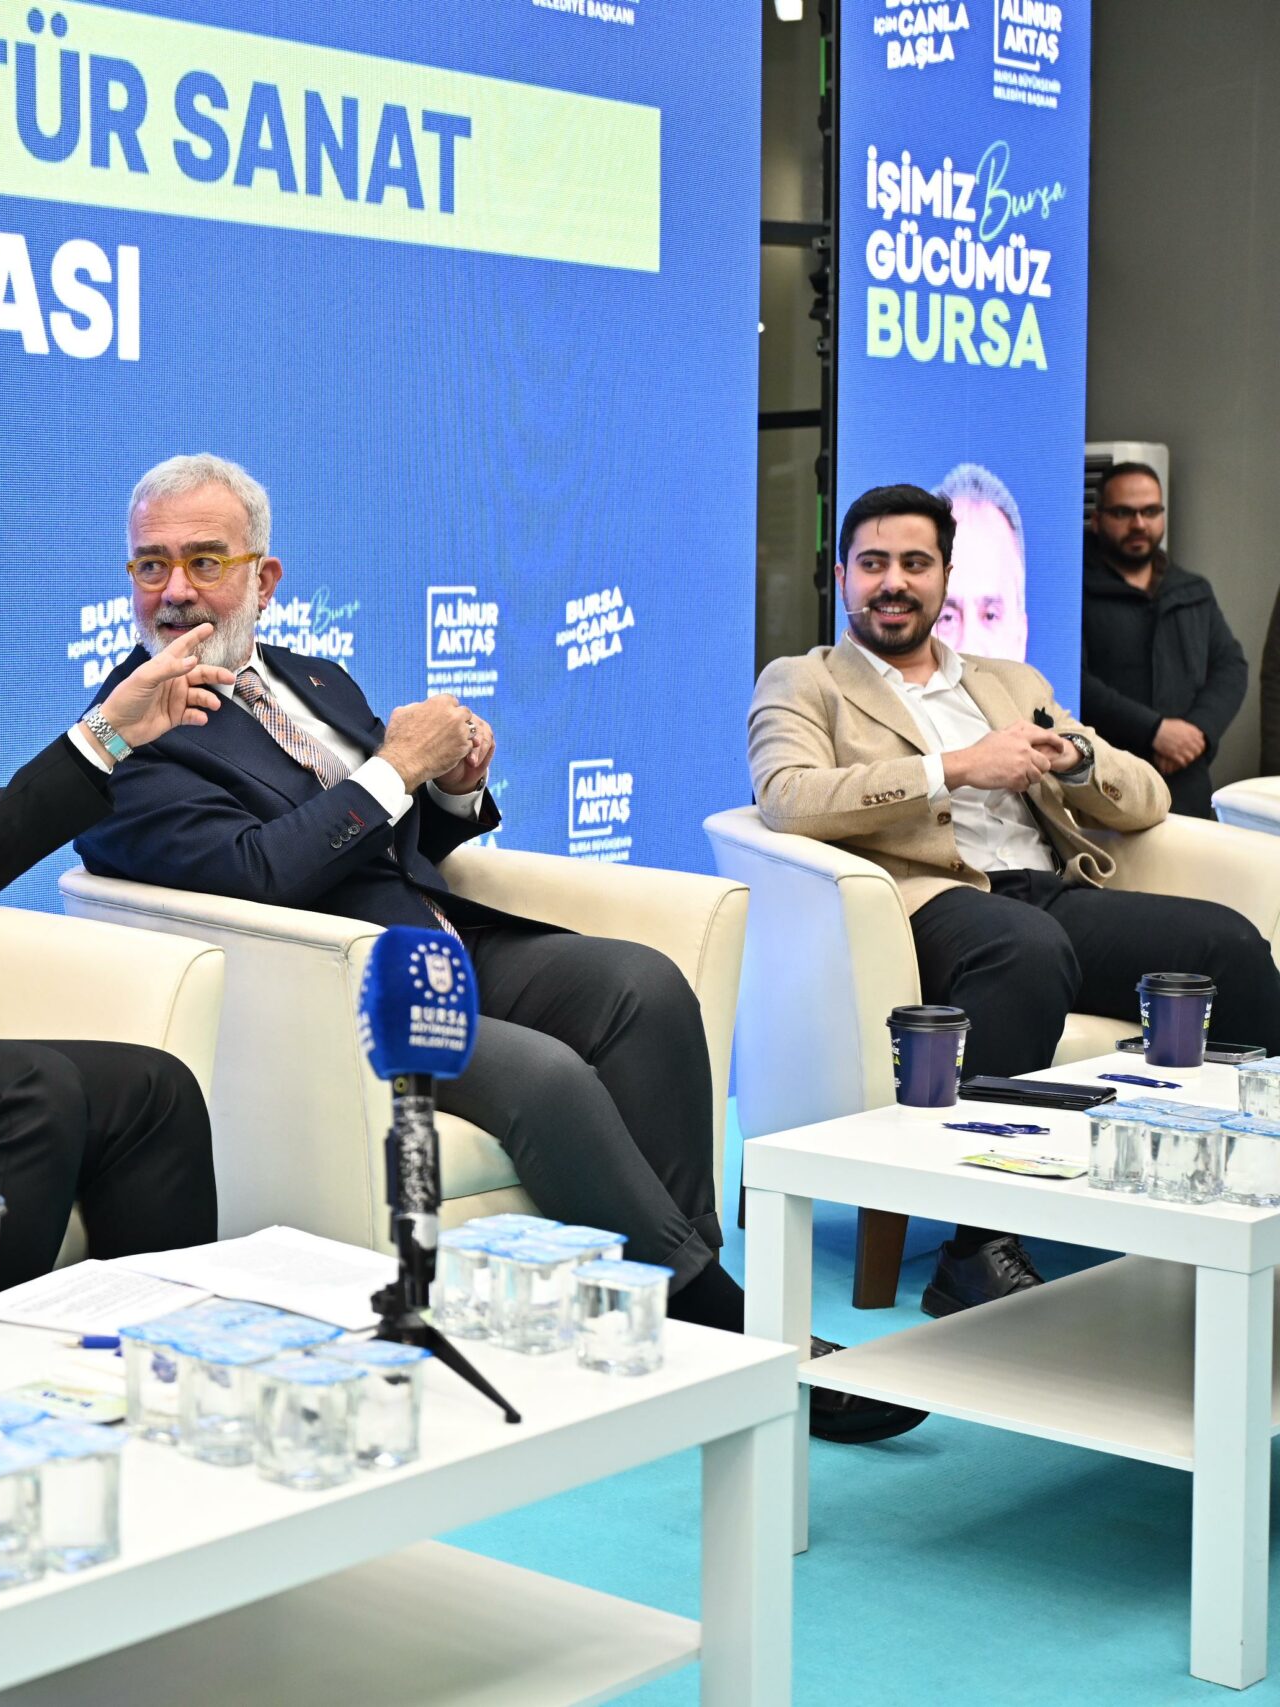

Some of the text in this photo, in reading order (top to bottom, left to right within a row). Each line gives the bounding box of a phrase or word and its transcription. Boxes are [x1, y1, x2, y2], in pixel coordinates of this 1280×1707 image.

[897, 2, 970, 38] CANLA
[886, 33, 955, 70] BAŞLA
[1003, 24, 1060, 64] AKTAŞ
[172, 70, 472, 216] SANAT
[866, 144, 977, 222] İŞİMİZ
[866, 219, 1052, 298] GÜCÜMÜZ
[866, 285, 1049, 371] BURSA
[81, 595, 135, 633] BUR
[256, 596, 312, 631] ŞİMİZ
[434, 598, 499, 629] ALİNUR
[565, 586, 624, 624] BURSA
[437, 629, 496, 656] AKTAŞ
[576, 605, 635, 645] CANLA
[567, 633, 623, 671] BAŞLA
[575, 771, 633, 800] ALİNUR
[578, 798, 631, 824] AKTAŞ
